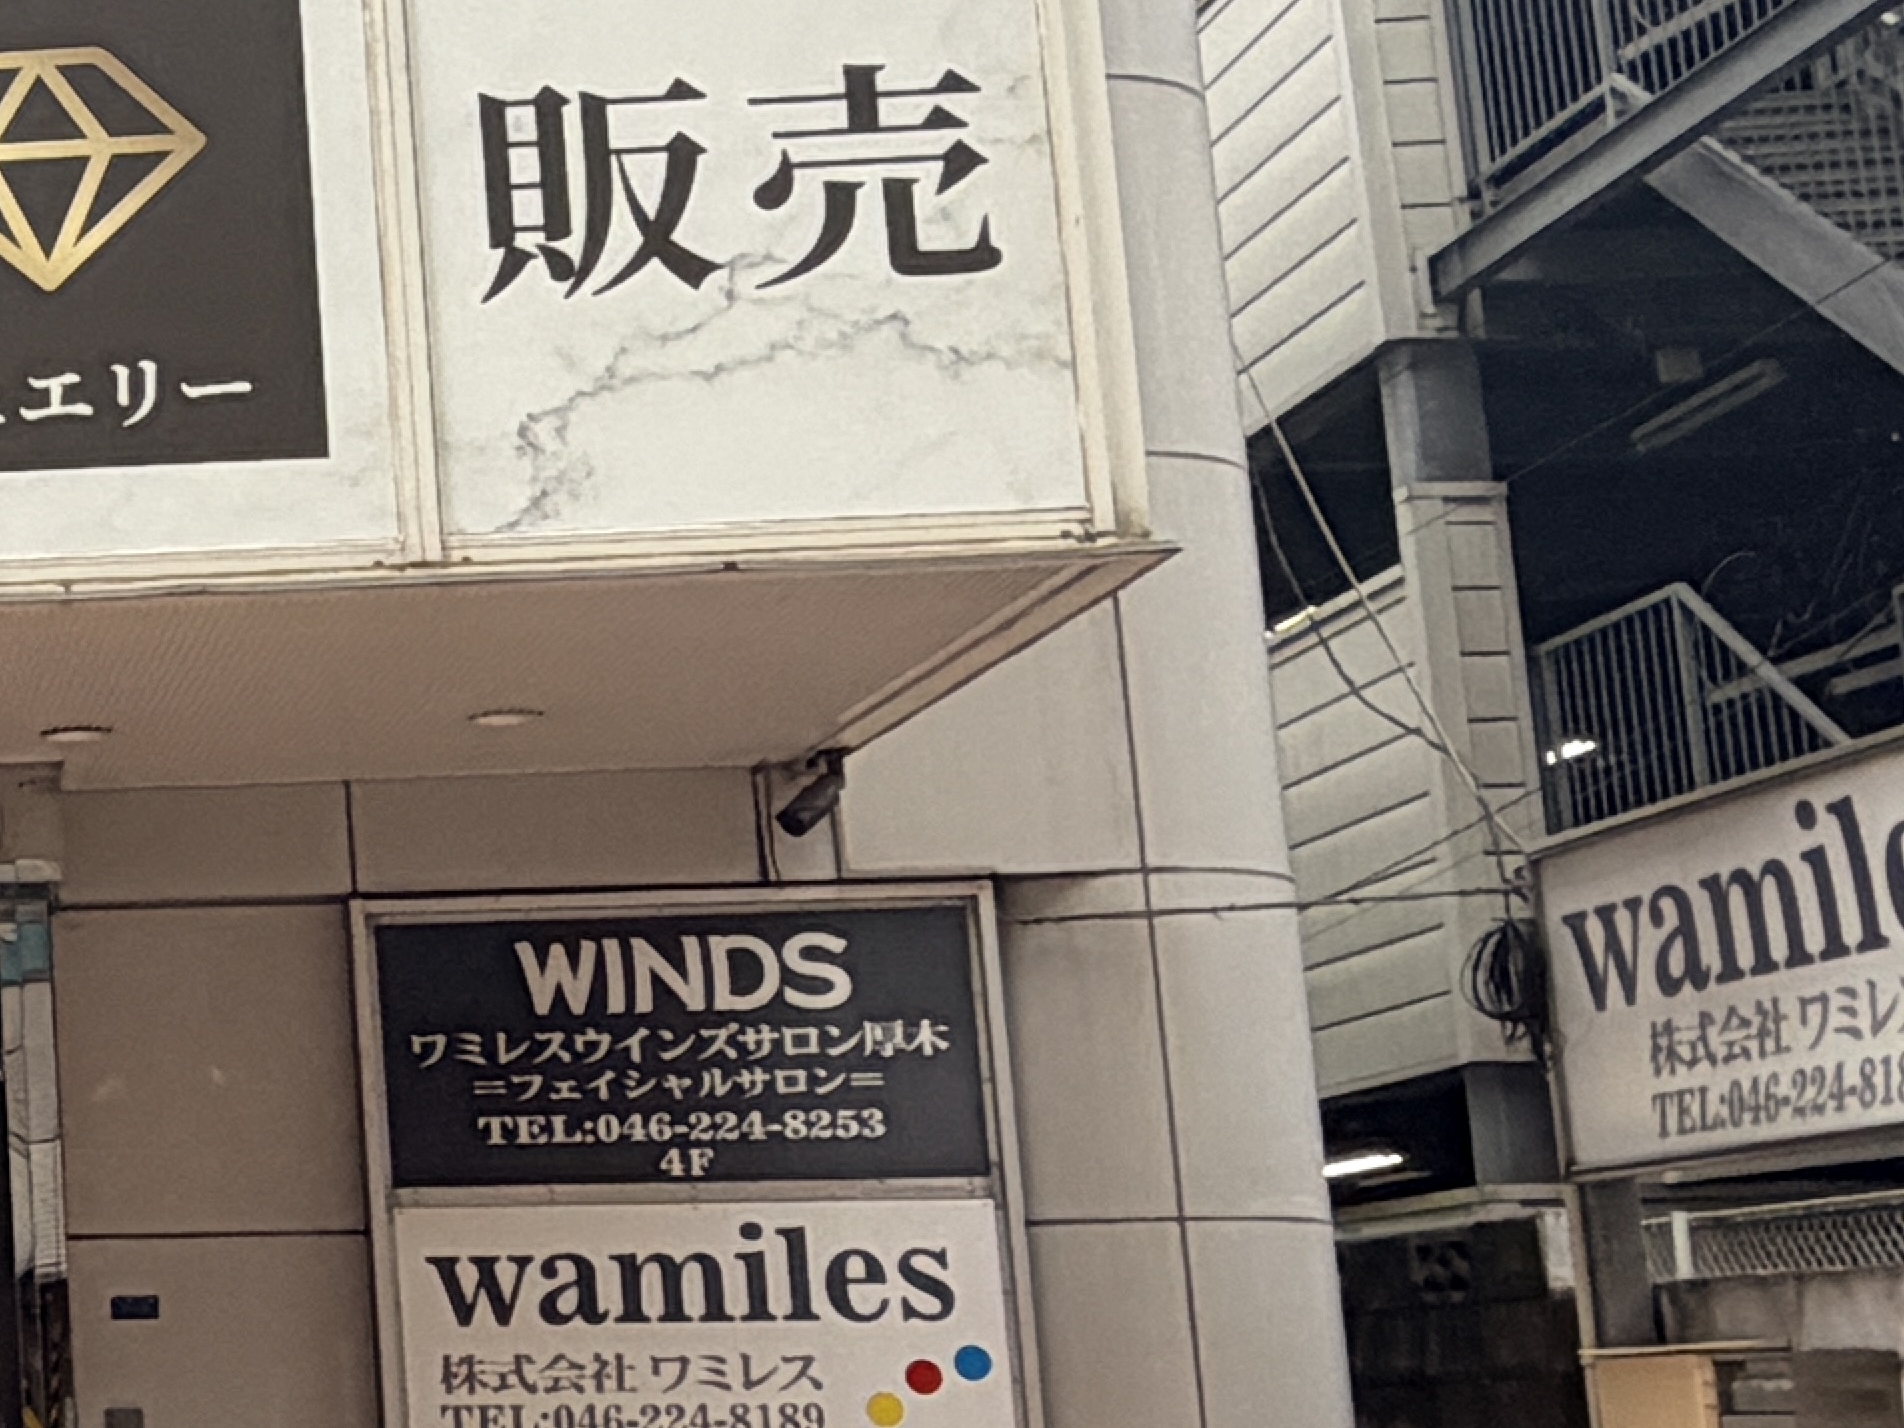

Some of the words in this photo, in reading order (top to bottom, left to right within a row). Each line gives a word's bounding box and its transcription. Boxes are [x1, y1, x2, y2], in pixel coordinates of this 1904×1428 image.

[476, 64, 1003, 304] 販売
[514, 932, 854, 1017] WINDS
[1649, 996, 1791, 1078] 株式会社
[1798, 977, 1904, 1052] ワミレ
[476, 1108, 888, 1146] TEL:046-224-8253
[659, 1148, 715, 1177] 4F
[424, 1222, 958, 1328] wamiles
[439, 1353, 638, 1397] 株式会社
[649, 1352, 825, 1392] ワミレス
